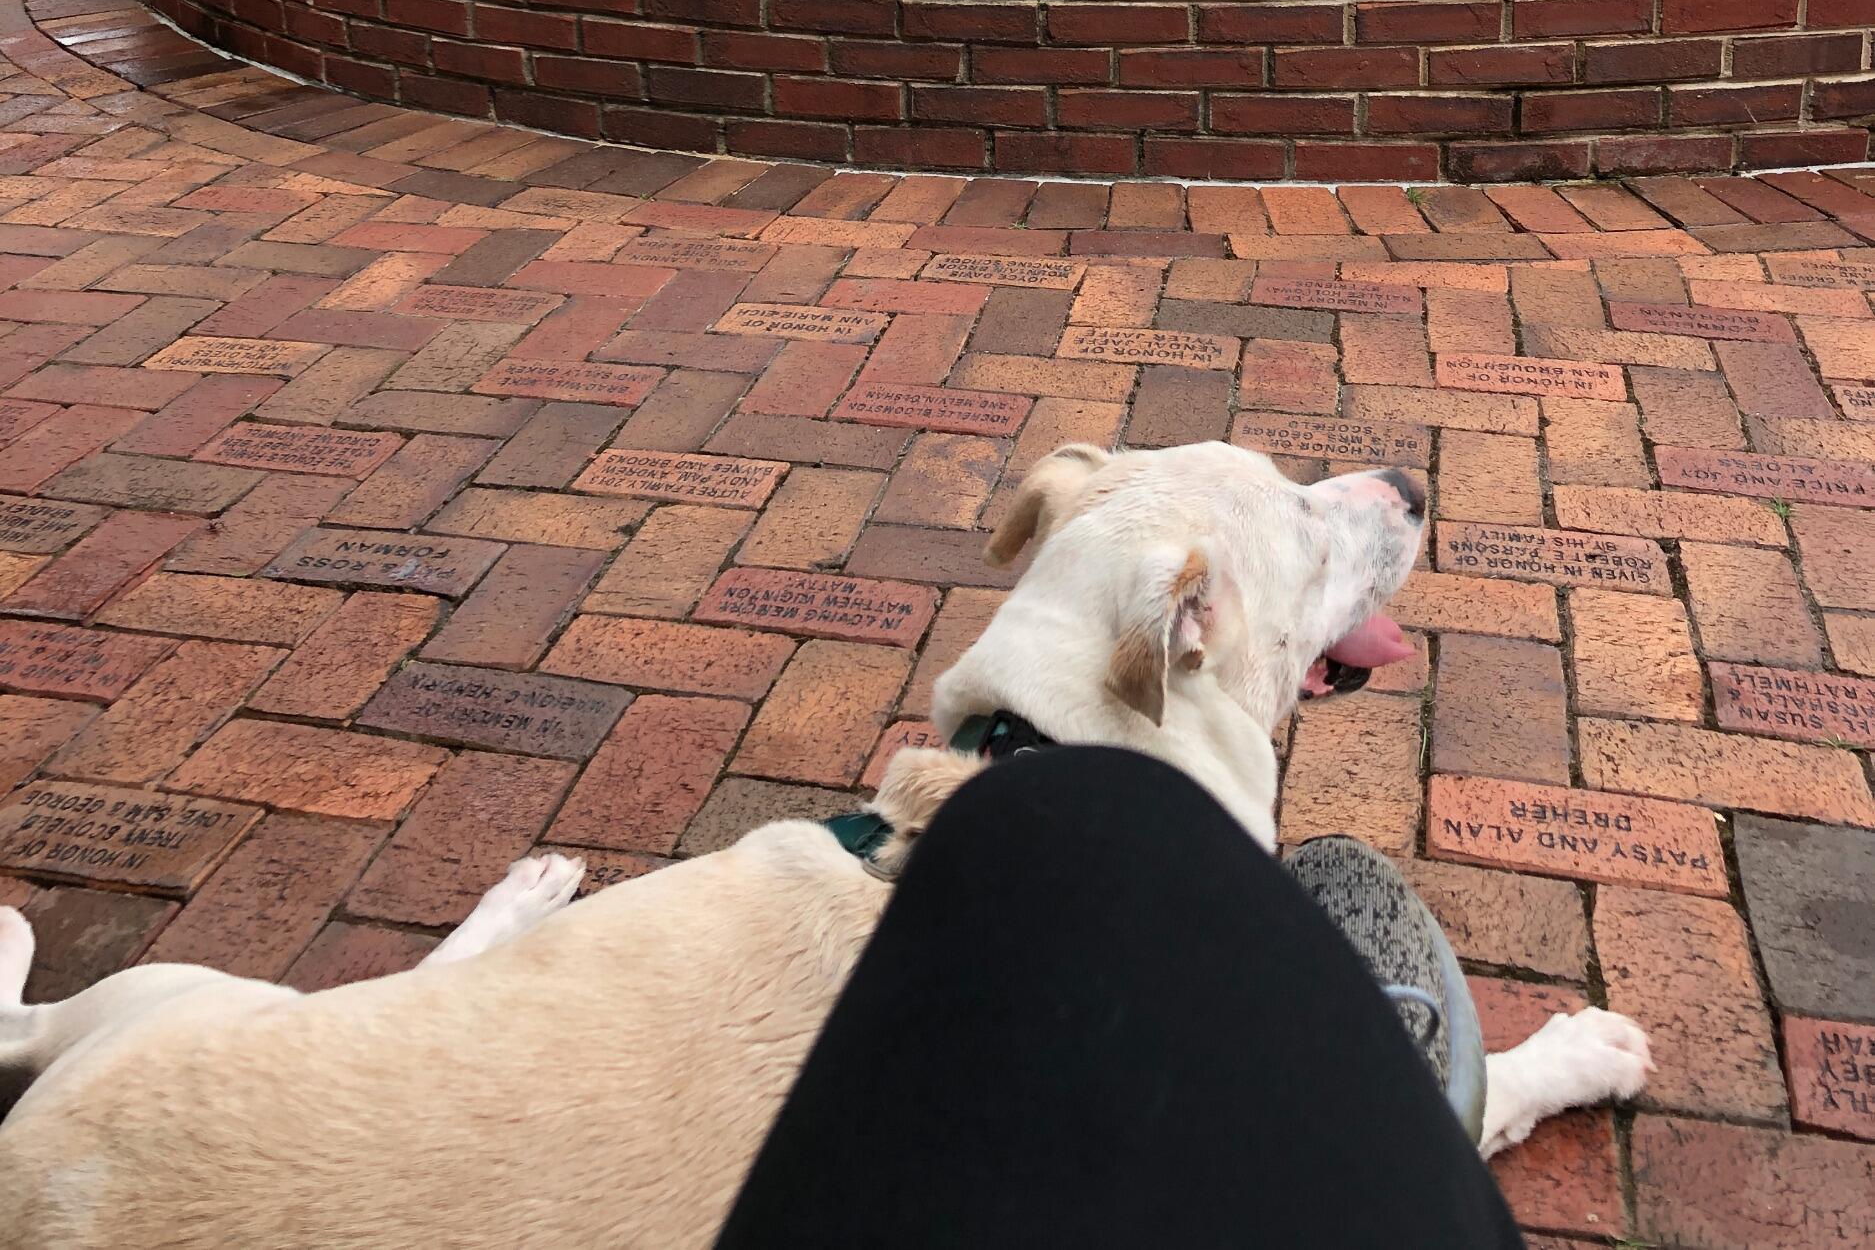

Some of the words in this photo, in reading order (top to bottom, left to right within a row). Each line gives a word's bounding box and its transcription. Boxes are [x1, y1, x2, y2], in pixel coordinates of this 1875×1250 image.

[935, 263, 989, 273] BROOK
[949, 269, 993, 281] DAVIS
[998, 273, 1048, 284] JOYCE
[740, 318, 765, 329] OF
[781, 310, 834, 323] MARIE
[838, 316, 876, 327] ANN
[768, 321, 829, 334] HONOR
[834, 327, 852, 337] IN
[1084, 328, 1146, 340] JAFFE
[1072, 336, 1131, 349] JAFFE
[1077, 345, 1106, 355] OF
[1112, 347, 1185, 360] HONOR
[1193, 352, 1213, 363] IN
[1444, 359, 1564, 377] BROUGHTON
[1570, 367, 1610, 380] NAN
[1465, 371, 1491, 383] OF
[1498, 374, 1565, 389] HONOR
[1573, 380, 1593, 392] IN
[1240, 426, 1314, 442] GEORGE
[1326, 434, 1363, 448] MRS
[1268, 438, 1293, 450] OF
[1298, 441, 1363, 455] HONOR
[1368, 446, 1386, 458] IN
[606, 455, 673, 471] BROOKS
[676, 460, 710, 474] AND
[714, 462, 775, 477] BAYNES
[628, 480, 682, 496] FAMILY
[1730, 474, 1782, 487] AND
[1789, 478, 1866, 495] PRICE
[1479, 529, 1546, 547] FAMILY
[1551, 536, 1585, 549] HIS
[334, 541, 452, 560] FORMAN
[1448, 540, 1539, 558] PARSONS
[1593, 539, 1616, 553] BY
[294, 556, 371, 572] ROSS
[1454, 554, 1479, 567] OF
[1485, 556, 1556, 575] HONOR
[1573, 553, 1653, 572] ROBERT
[1562, 564, 1582, 579] IN
[1590, 566, 1652, 585] GIVEN
[718, 600, 801, 621] MEMORY
[820, 594, 915, 617] MATTHEW
[804, 608, 878, 627] LOVING
[880, 616, 904, 632] IN
[1728, 670, 1859, 701] RATHMELL
[1752, 692, 1875, 720] ARSHALL,
[18, 789, 107, 816] GEORGE
[123, 803, 173, 825] SAM
[1508, 799, 1634, 833] DREHER
[122, 828, 187, 850] TRENT
[1443, 818, 1526, 845] ALAN
[10, 839, 47, 859] OF
[1536, 830, 1600, 855] AND
[45, 841, 124, 868] HONOR
[122, 852, 150, 870] IN
[1611, 841, 1711, 871] PATSY
